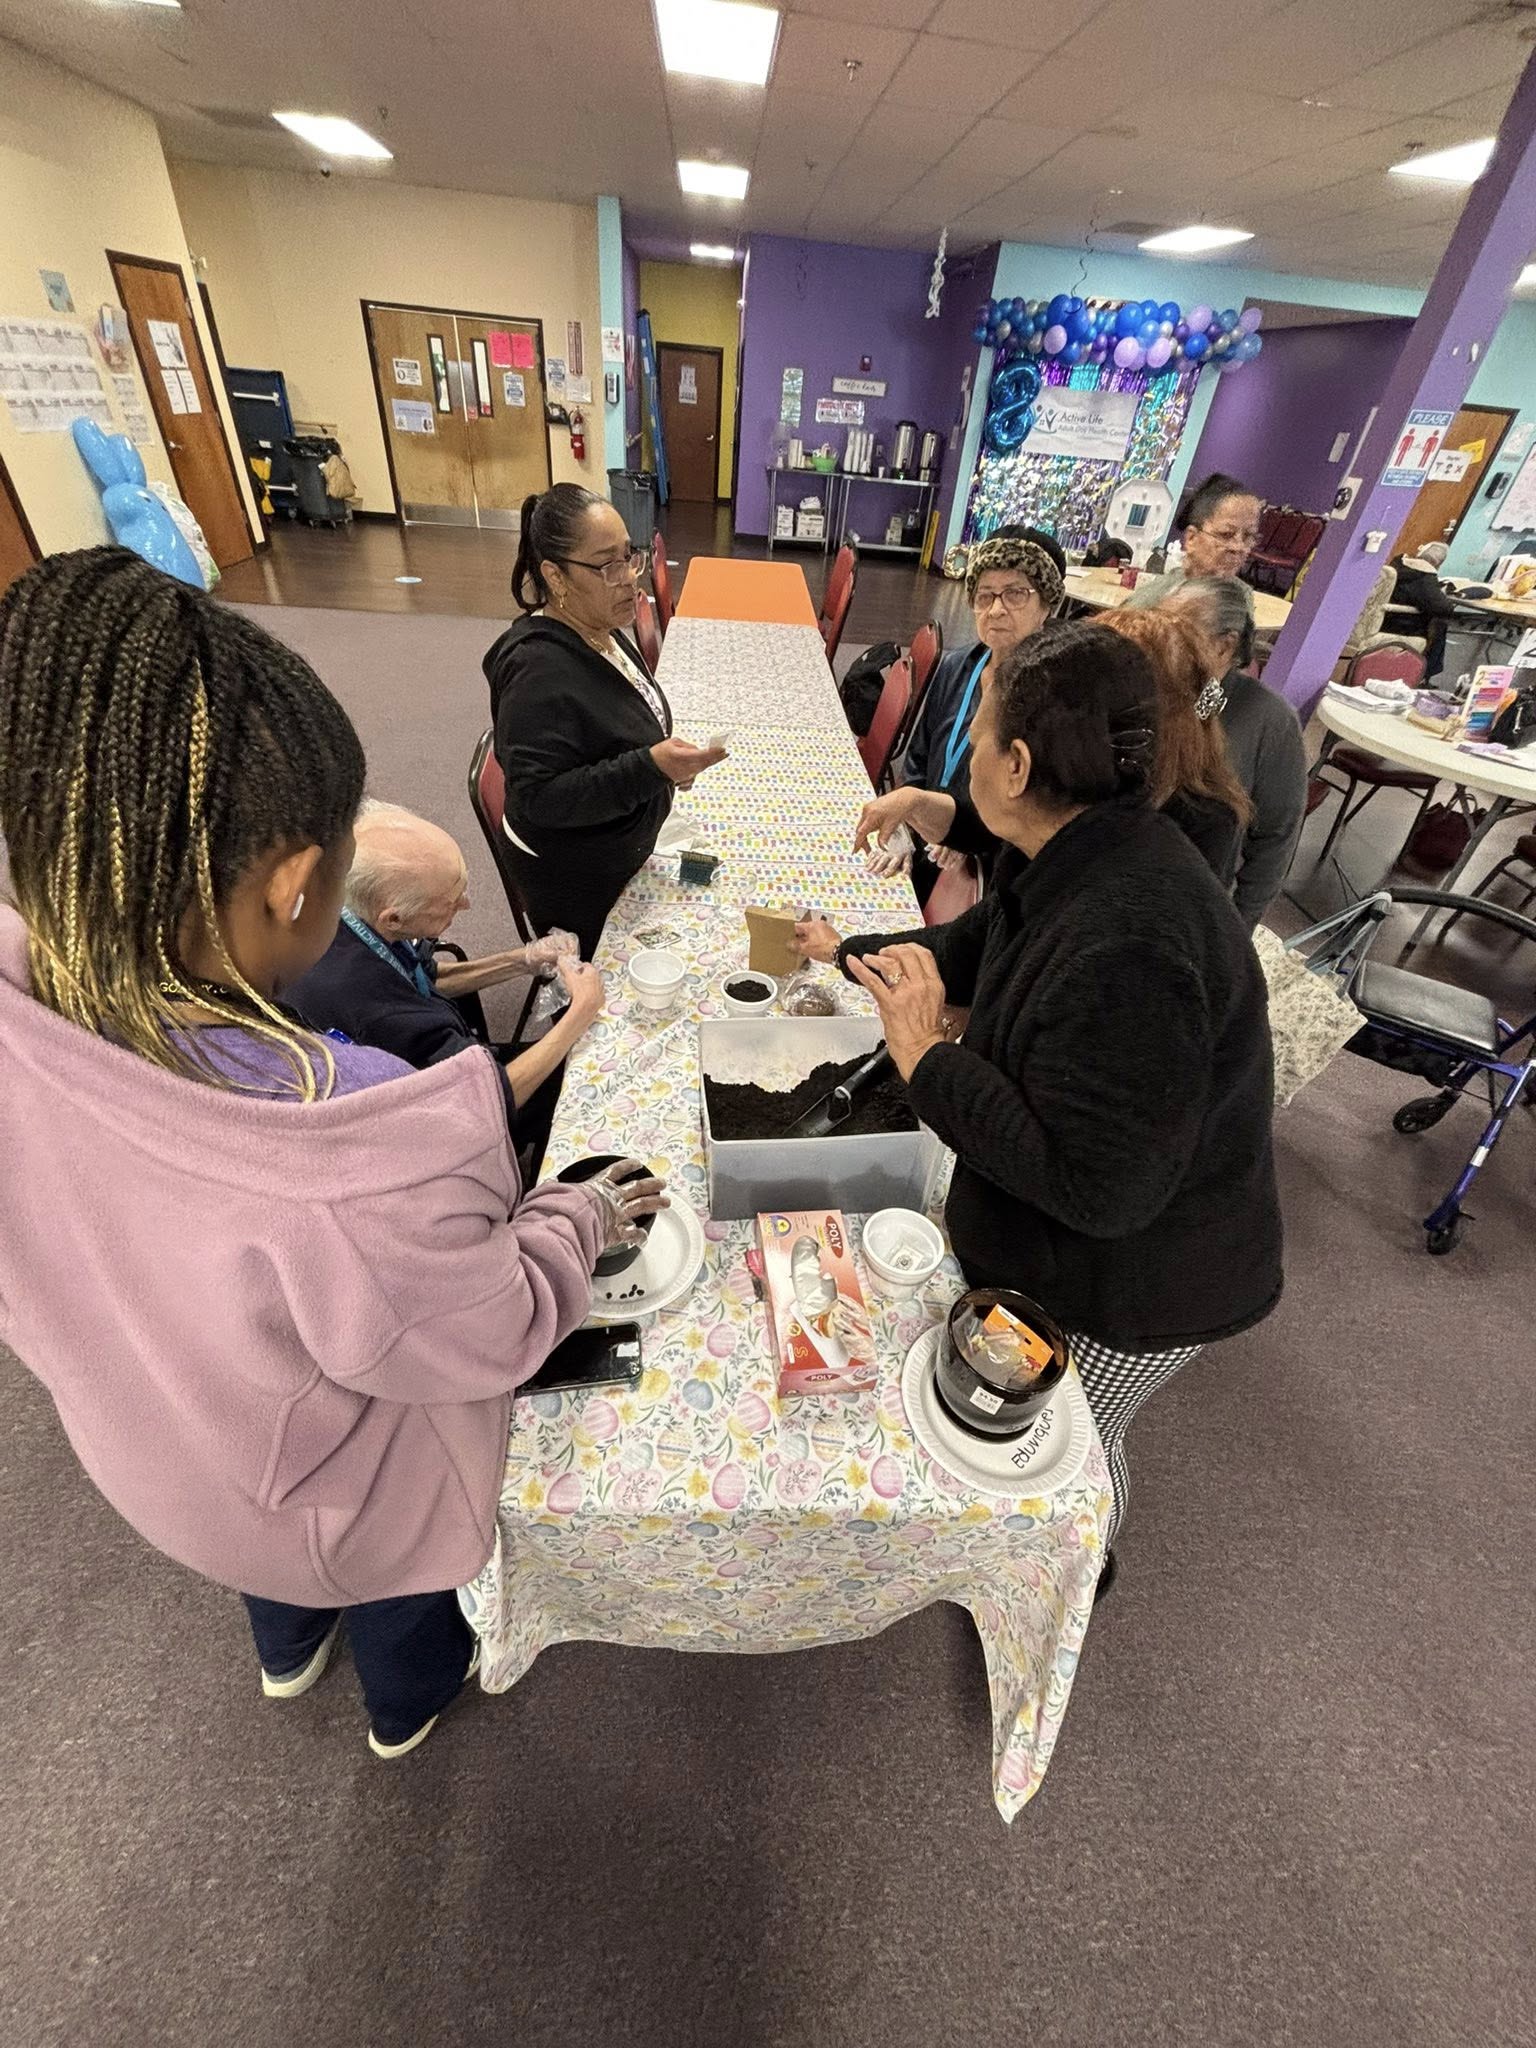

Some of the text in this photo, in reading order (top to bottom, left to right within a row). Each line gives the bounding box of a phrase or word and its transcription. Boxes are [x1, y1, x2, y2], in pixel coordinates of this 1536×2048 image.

[1060, 412, 1103, 425] Active Life
[1412, 413, 1449, 425] PLEASE
[347, 918, 378, 946] ACTIVE
[827, 1223, 842, 1249] POLY
